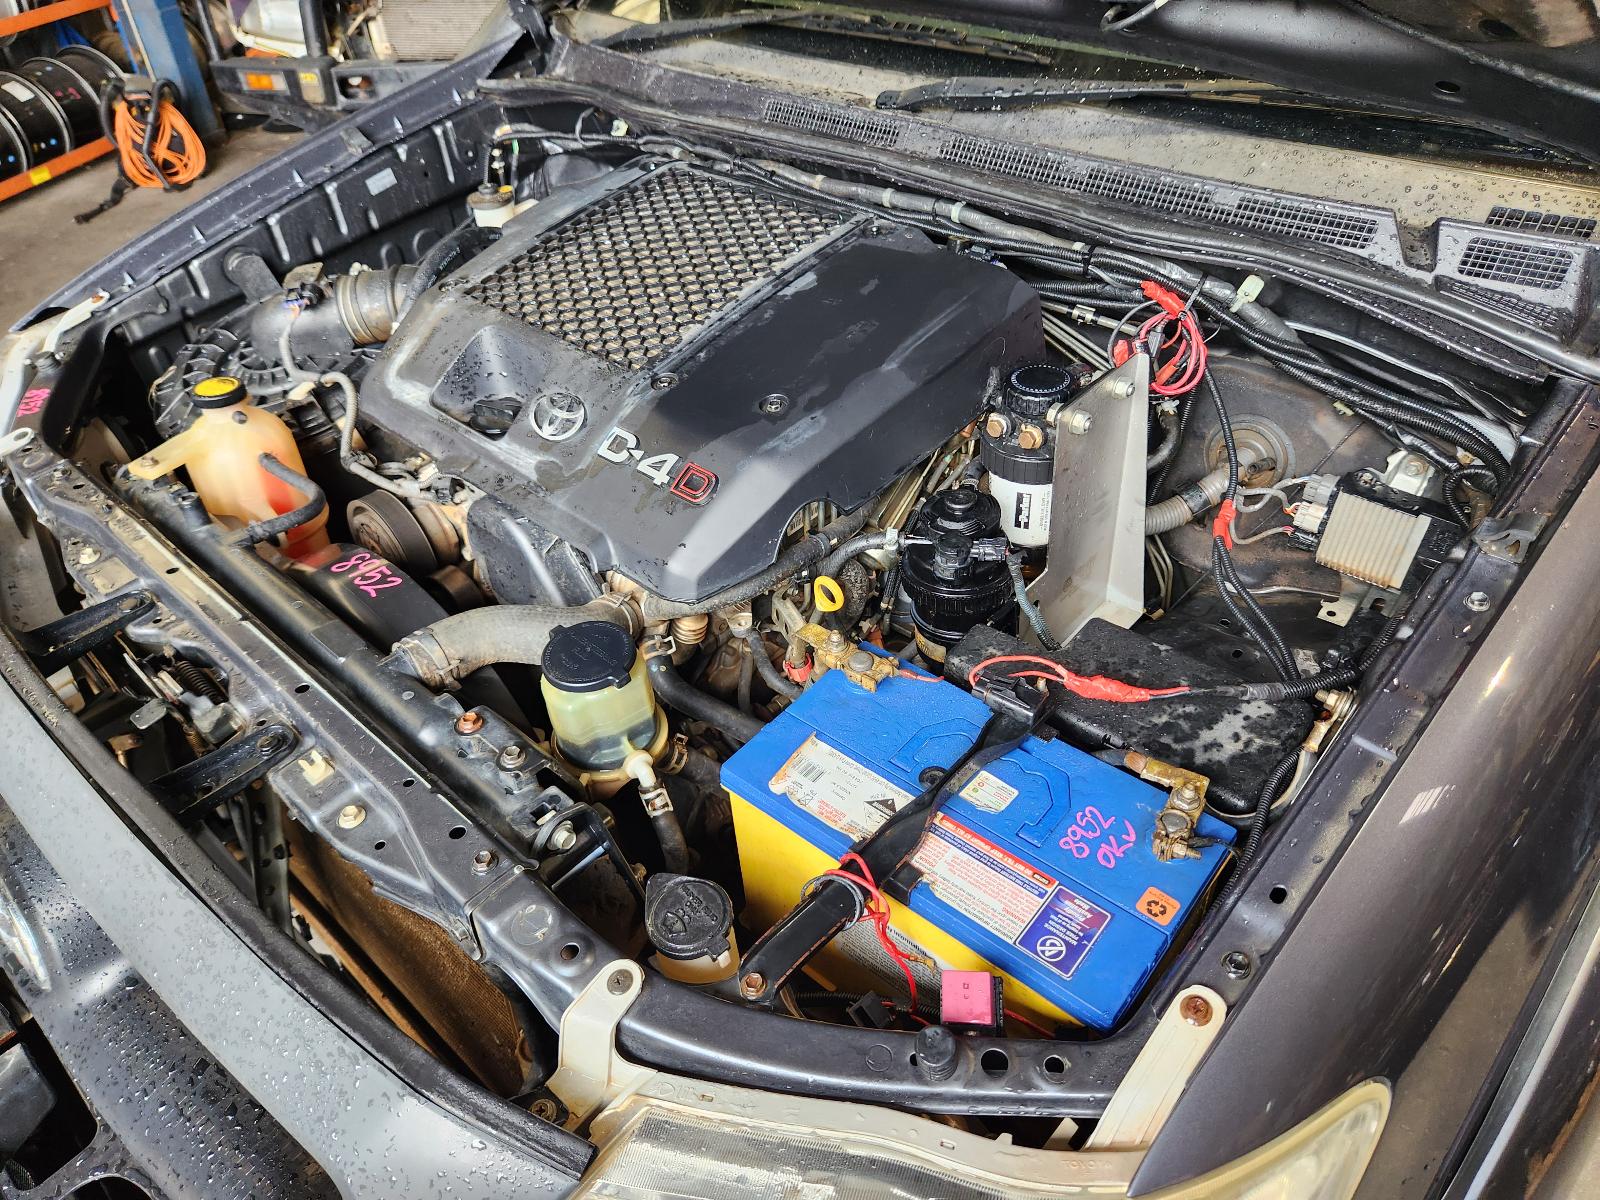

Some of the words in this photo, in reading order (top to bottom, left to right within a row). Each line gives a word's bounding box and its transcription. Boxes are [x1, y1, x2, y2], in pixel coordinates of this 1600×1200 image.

[1017, 492, 1031, 524] Parker
[330, 552, 403, 598] 8952
[1059, 806, 1116, 858] 8952
[1001, 906, 1027, 924] WARNING
